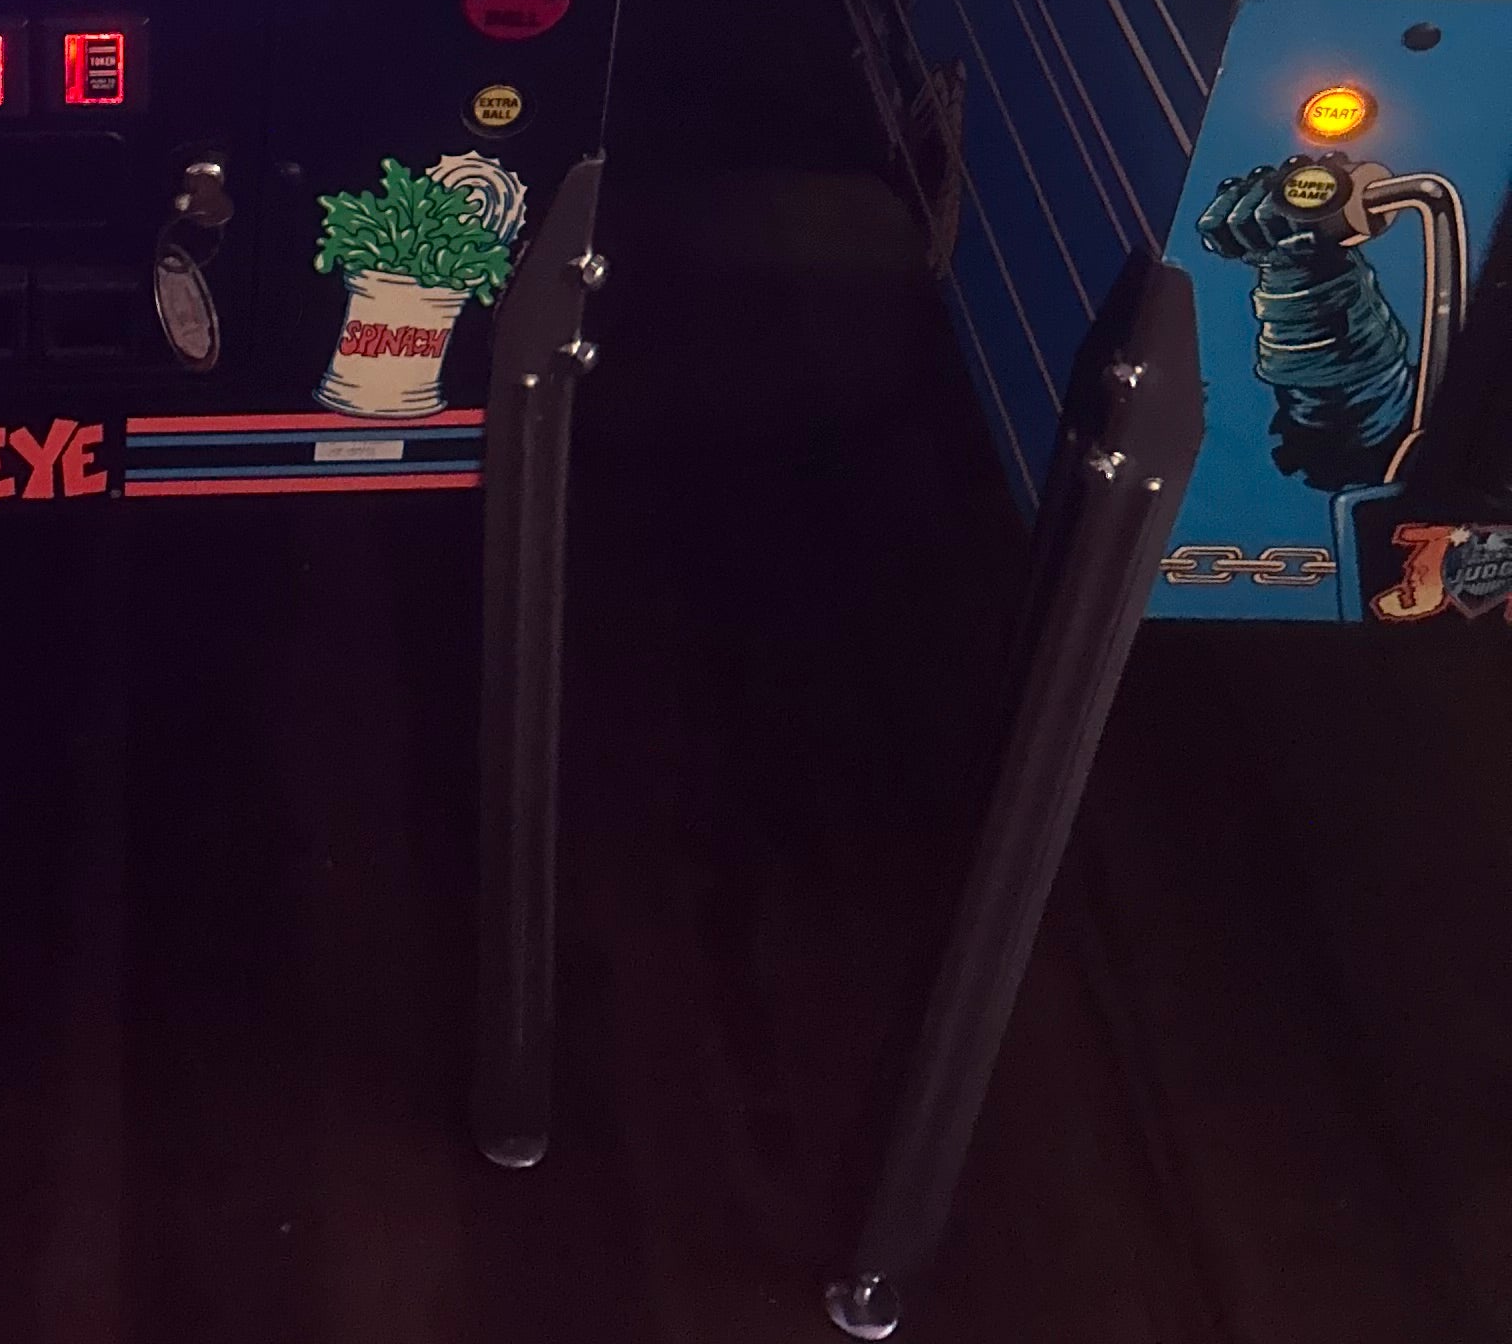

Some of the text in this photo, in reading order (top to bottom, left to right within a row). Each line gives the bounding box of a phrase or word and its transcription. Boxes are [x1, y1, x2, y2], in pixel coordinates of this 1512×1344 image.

[478, 97, 519, 109] EXTRA
[482, 109, 513, 120] BALL
[1312, 106, 1359, 120] START
[1288, 179, 1336, 192] SUPER
[1287, 189, 1328, 200] GAME
[340, 319, 451, 359] SPINACH
